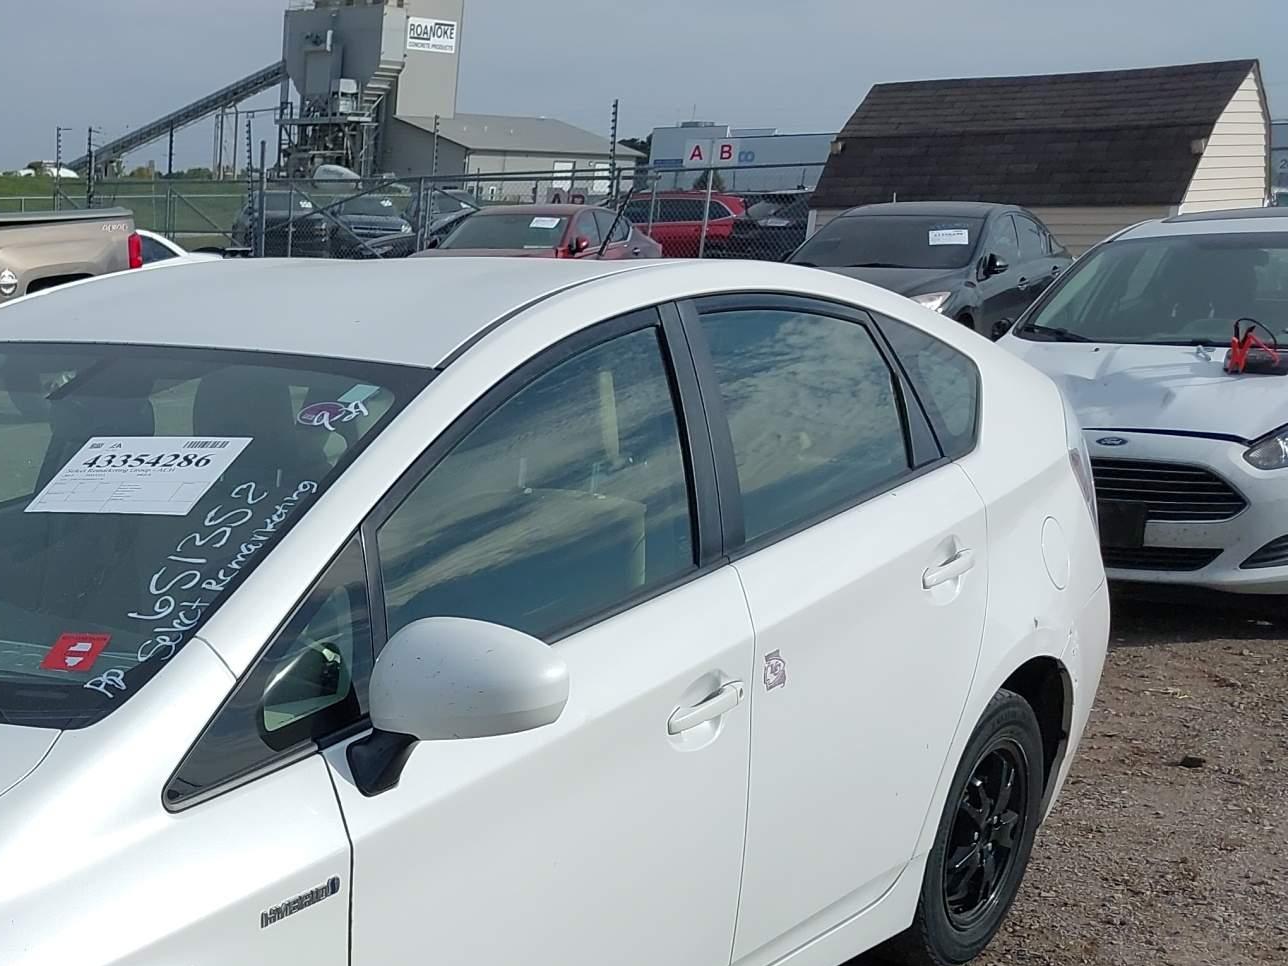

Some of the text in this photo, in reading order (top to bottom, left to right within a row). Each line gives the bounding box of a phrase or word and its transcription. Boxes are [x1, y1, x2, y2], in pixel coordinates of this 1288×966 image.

[409, 22, 455, 40] ROANOKE
[689, 144, 703, 160] A
[720, 144, 732, 160] B
[83, 453, 217, 468] 43354286
[128, 482, 268, 620] 651352
